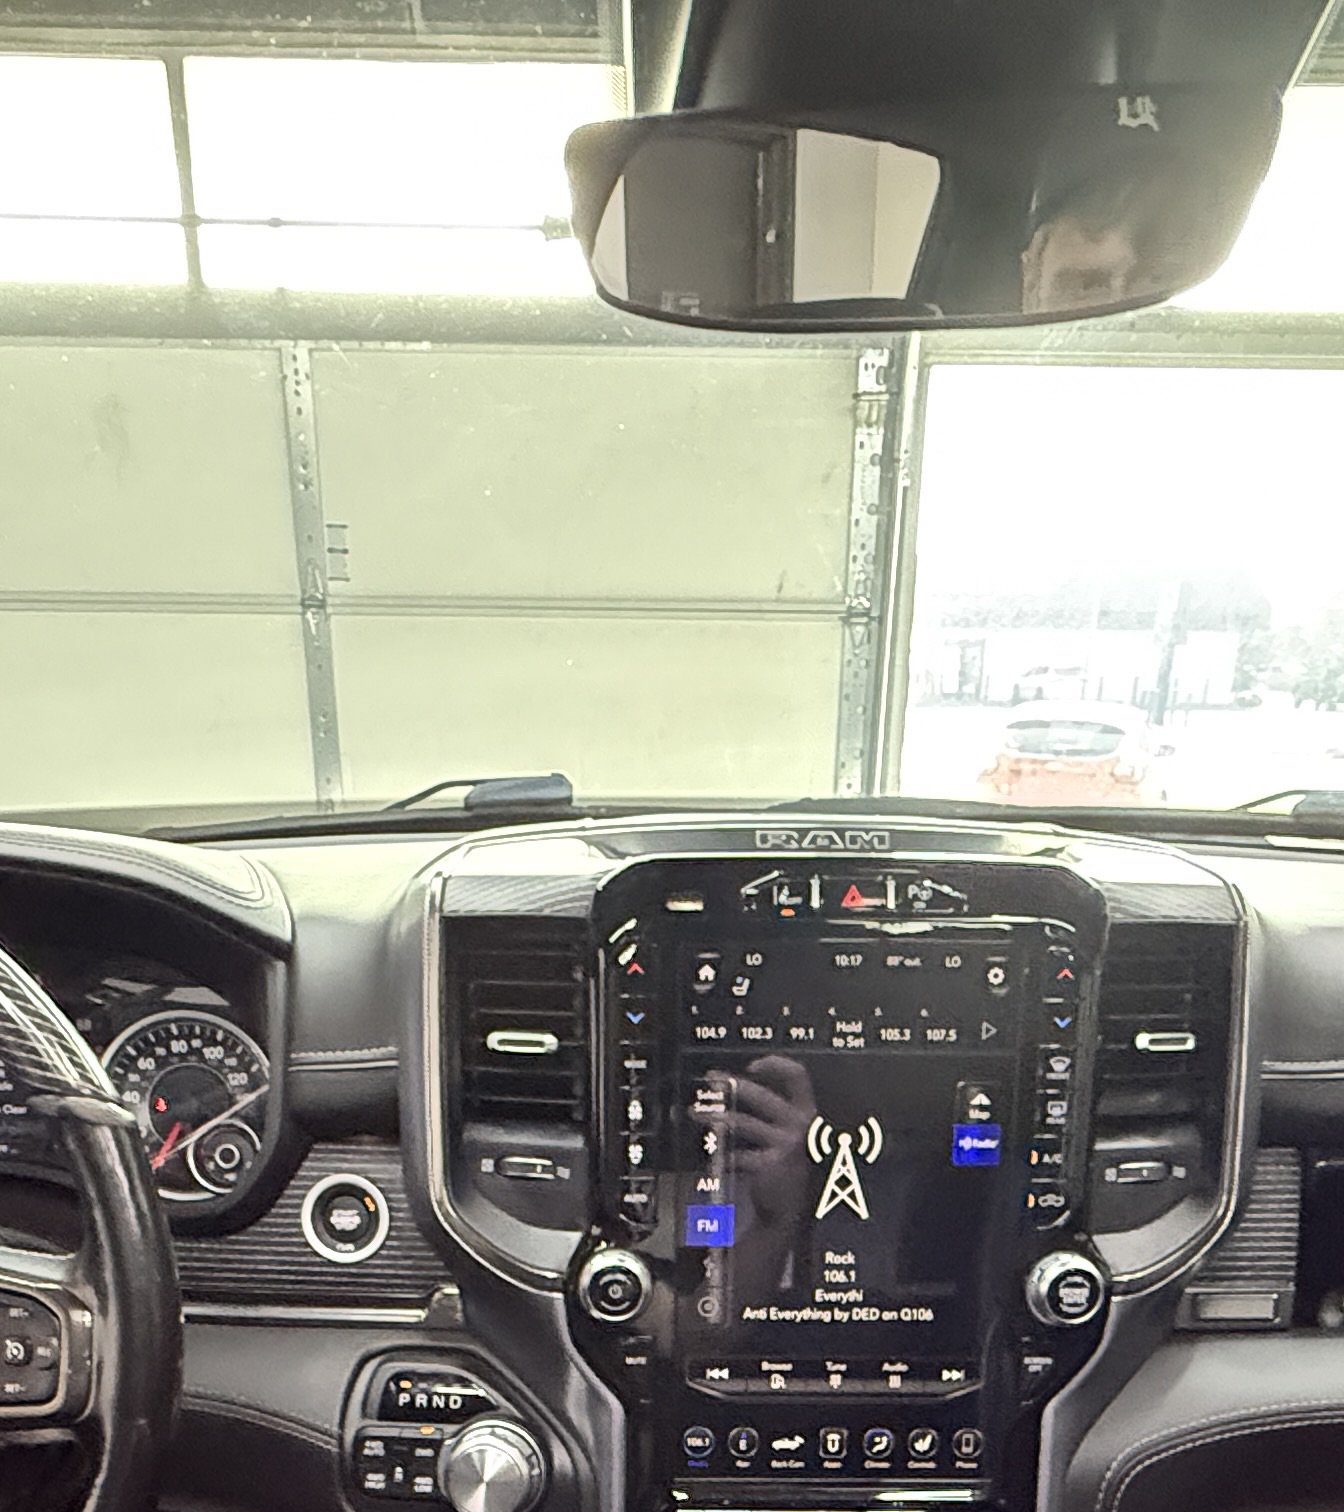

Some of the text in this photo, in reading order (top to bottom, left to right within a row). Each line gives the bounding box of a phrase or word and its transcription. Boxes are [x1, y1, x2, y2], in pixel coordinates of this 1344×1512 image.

[756, 830, 890, 849] RAM
[695, 1020, 957, 1042] 104.9 102.3 99.1 Hold 105.3 107.5
[170, 1039, 188, 1053] 80
[832, 1036, 865, 1049] to Set
[137, 1057, 155, 1070] 60
[696, 1178, 720, 1192] AM
[697, 1219, 719, 1233] FM
[825, 1251, 856, 1265] Rock
[824, 1269, 856, 1283] 106.1
[814, 1288, 863, 1305] Everythi
[743, 1307, 934, 1323] Anti Everything by DED on Q106
